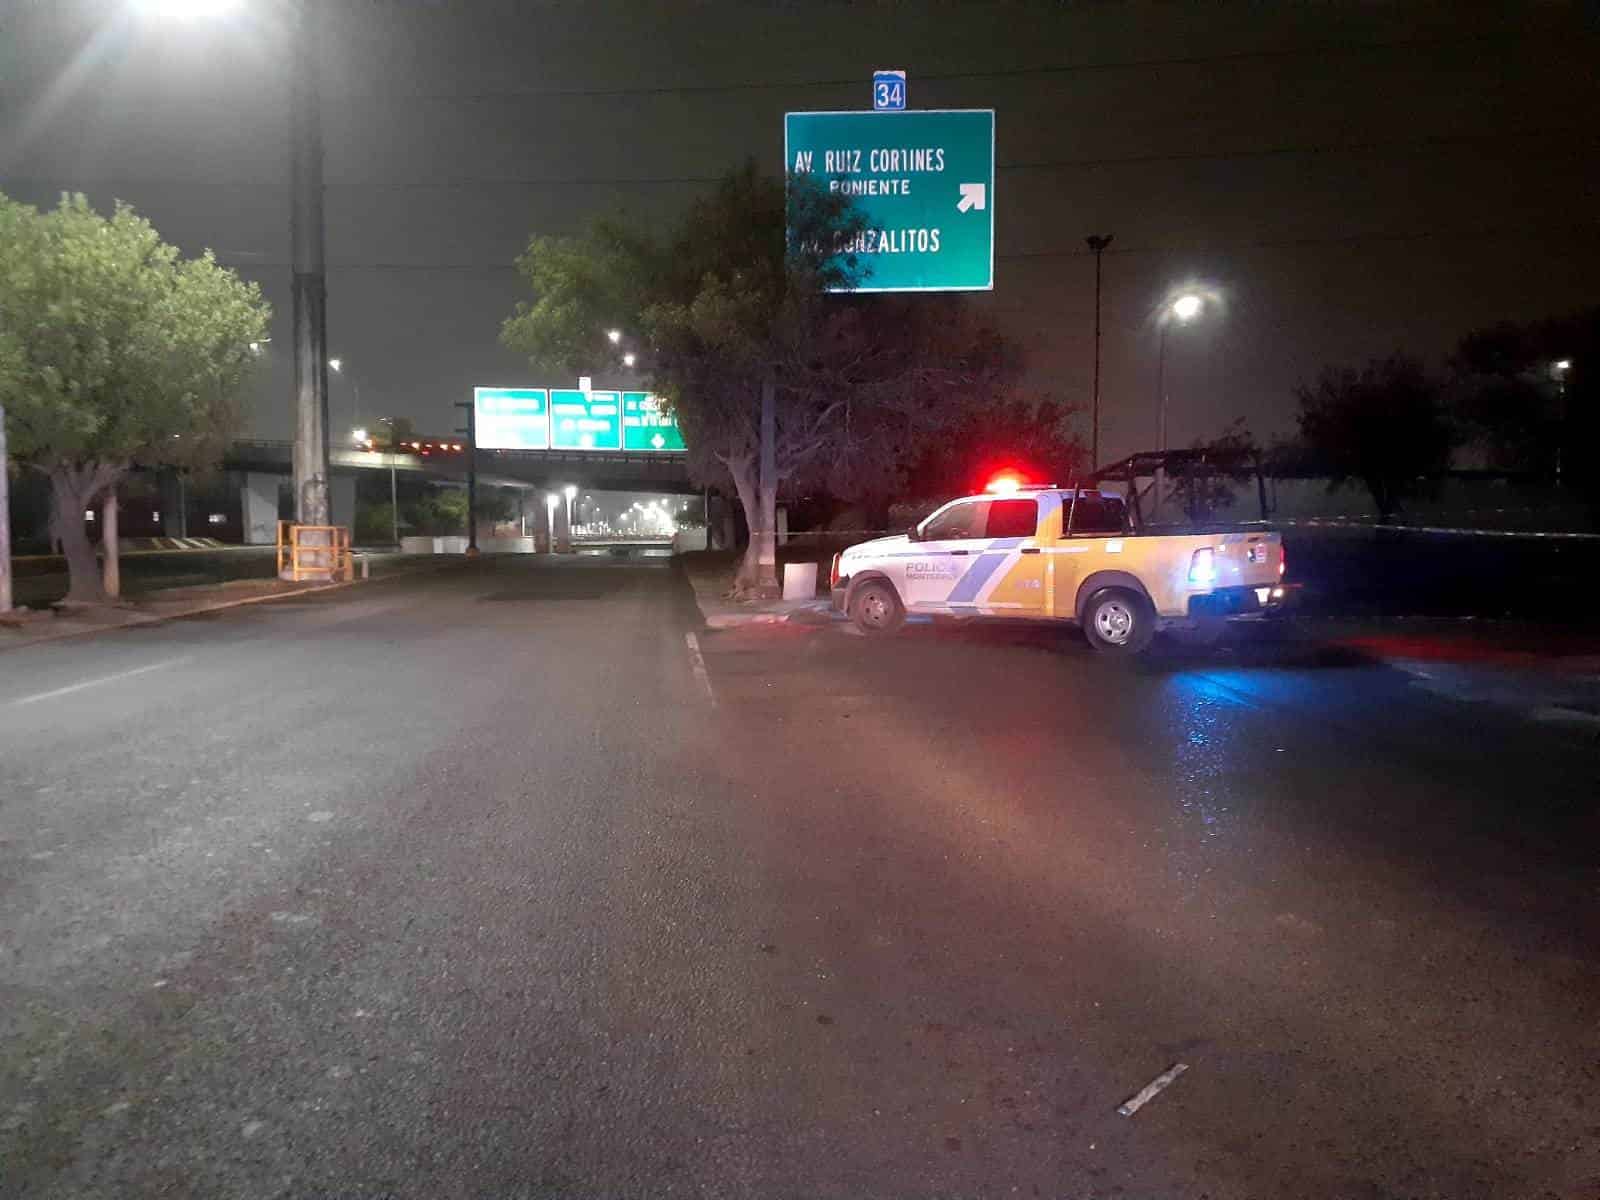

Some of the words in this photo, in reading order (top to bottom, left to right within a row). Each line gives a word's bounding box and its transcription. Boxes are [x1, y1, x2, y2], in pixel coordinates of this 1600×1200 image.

[877, 83, 902, 107] 34
[794, 151, 815, 173] AV.
[825, 150, 862, 173] RUIZ
[870, 148, 945, 172] CORTINES
[829, 179, 911, 195] PONIENTE
[906, 562, 953, 572] POLIC
